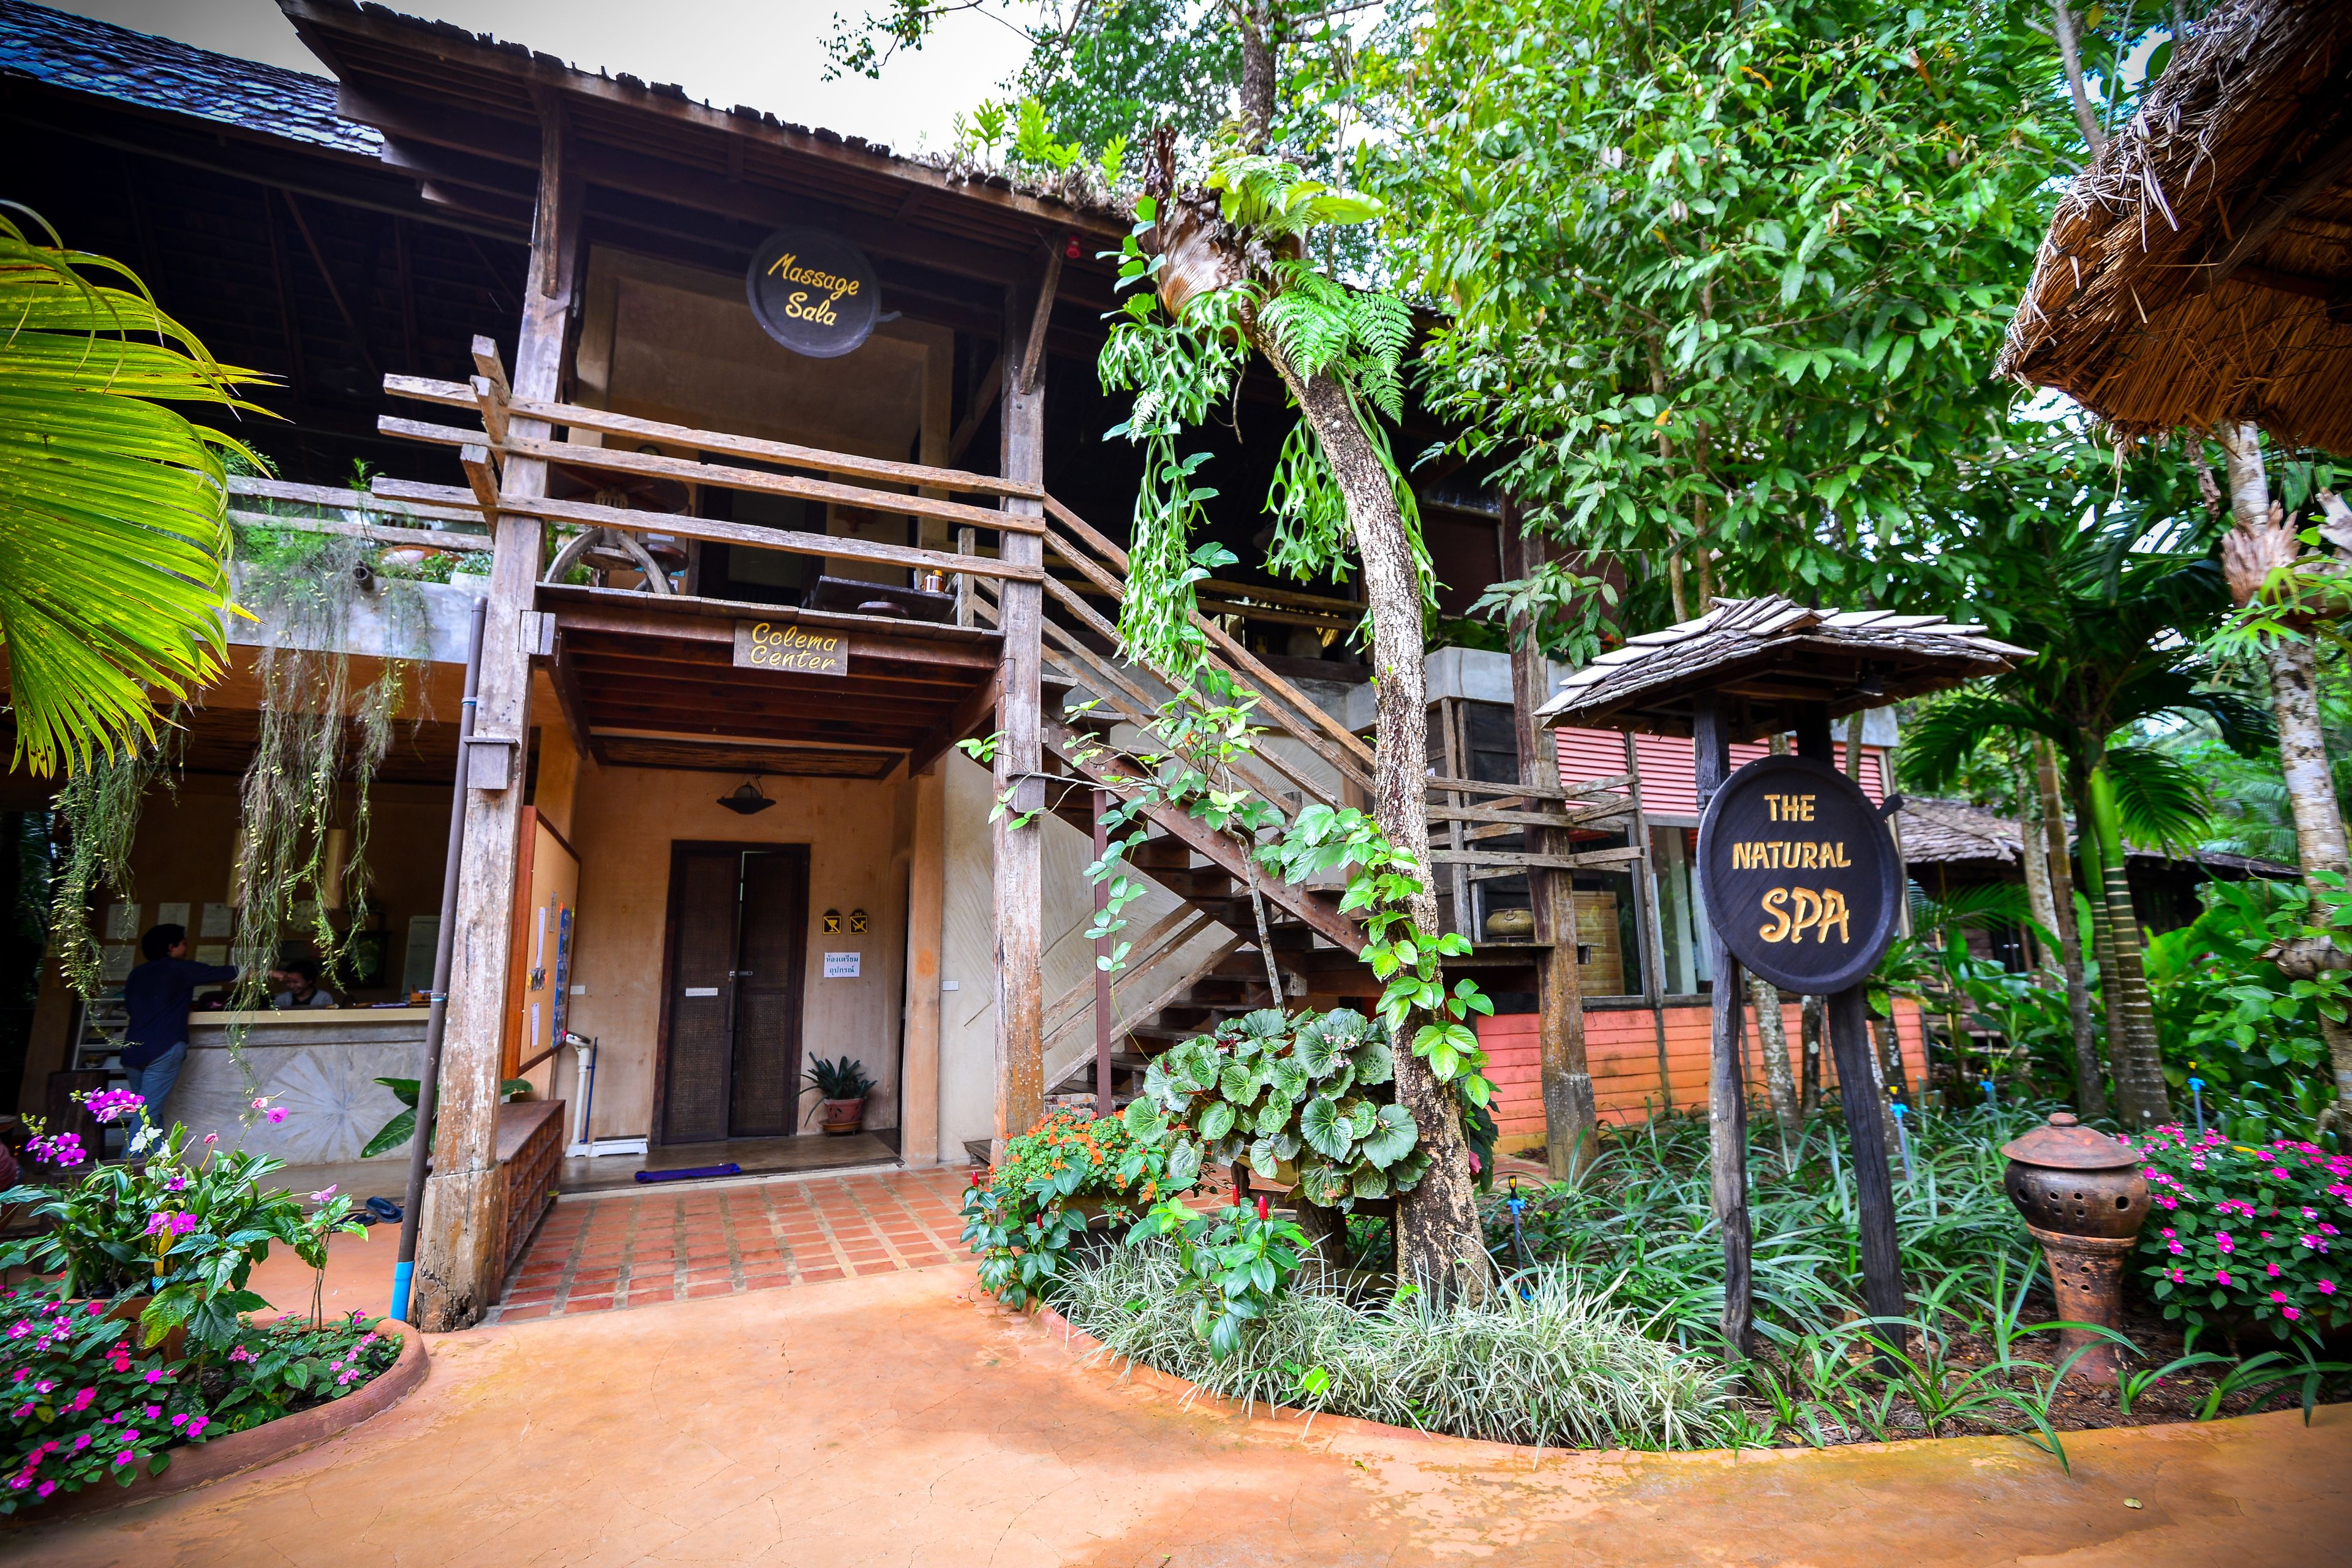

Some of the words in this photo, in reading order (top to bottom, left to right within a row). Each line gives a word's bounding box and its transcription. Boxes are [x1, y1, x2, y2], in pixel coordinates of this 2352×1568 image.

[767, 253, 859, 301] Massage
[785, 292, 837, 326] Sala
[752, 622, 839, 652] Colema
[750, 645, 837, 671] Center
[1764, 794, 1816, 822] THE
[1732, 842, 1852, 870] NATURAL
[1758, 886, 1850, 944] SPA
[829, 965, 855, 976] อุปกรณ์
